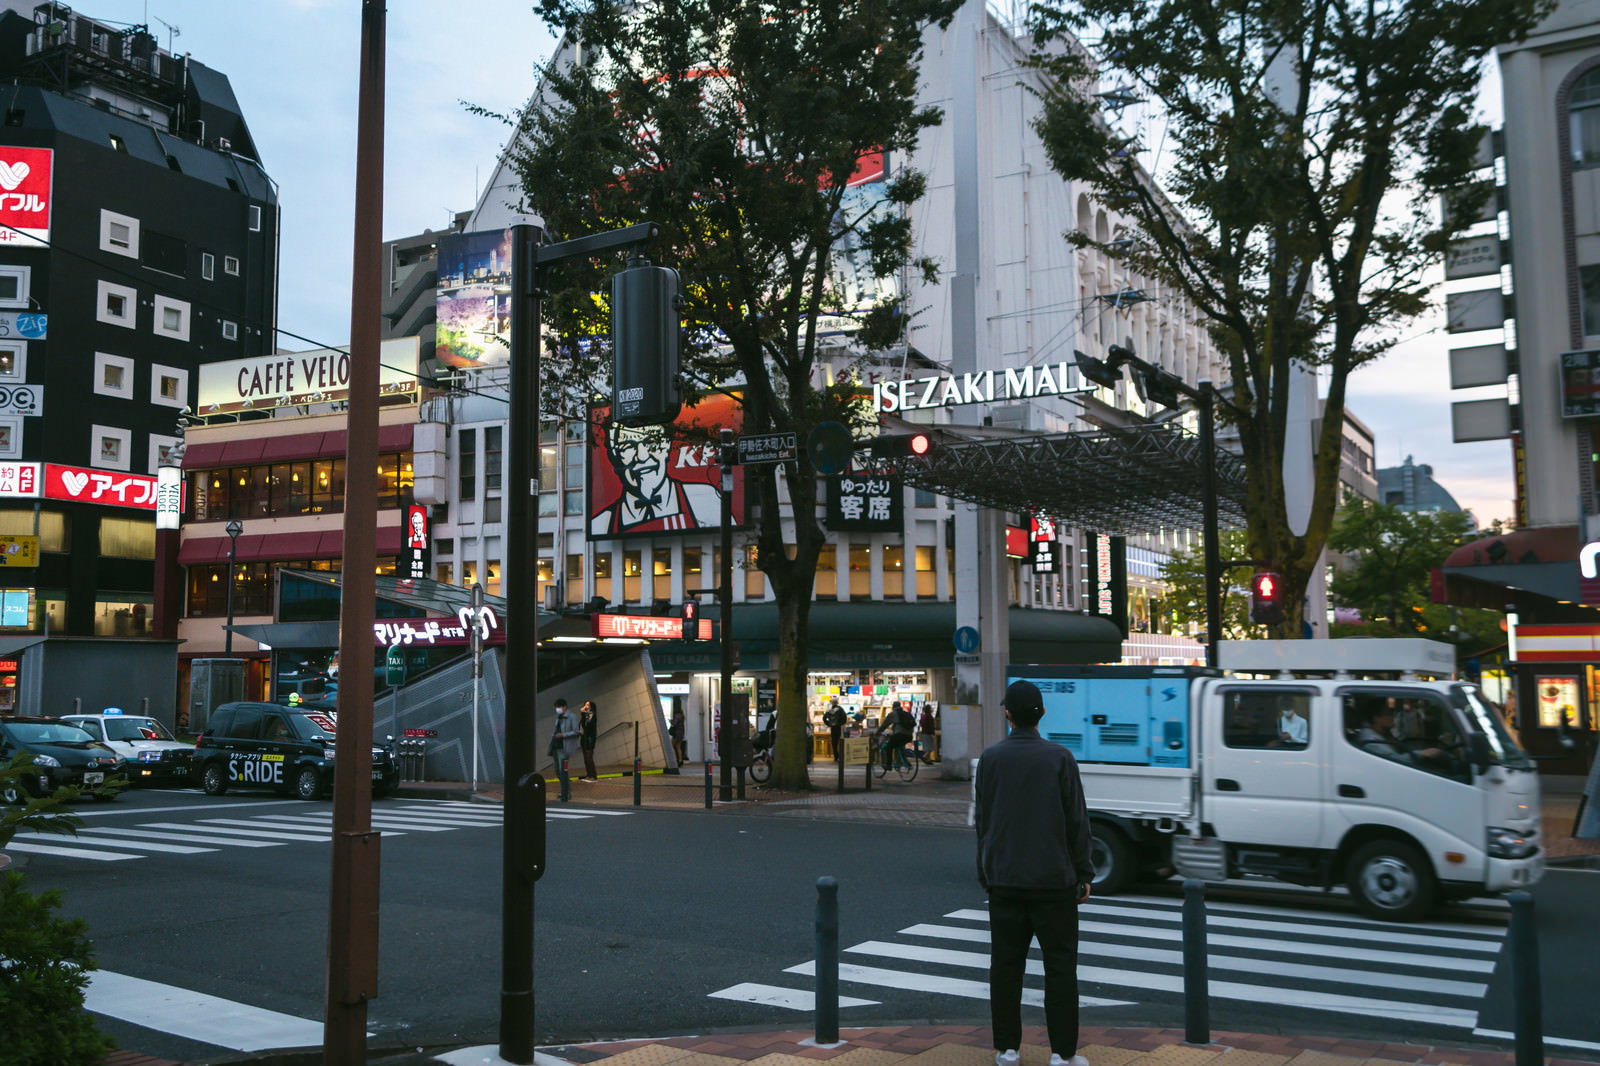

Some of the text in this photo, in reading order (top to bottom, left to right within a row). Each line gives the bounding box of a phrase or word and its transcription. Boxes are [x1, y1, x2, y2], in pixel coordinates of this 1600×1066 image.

[238, 357, 294, 397] CAFFÈ
[873, 361, 1098, 412] ISEZAKI MALL
[739, 436, 795, 453] 伊勢佐木町入口
[158, 483, 167, 513] VELOCE
[168, 484, 180, 514] VELOCE
[841, 480, 890, 494] ゆったり
[840, 495, 892, 521] 客席
[1098, 589, 1112, 615] SLOT
[373, 622, 440, 645] マリナード
[228, 760, 284, 784] S.RIDE
